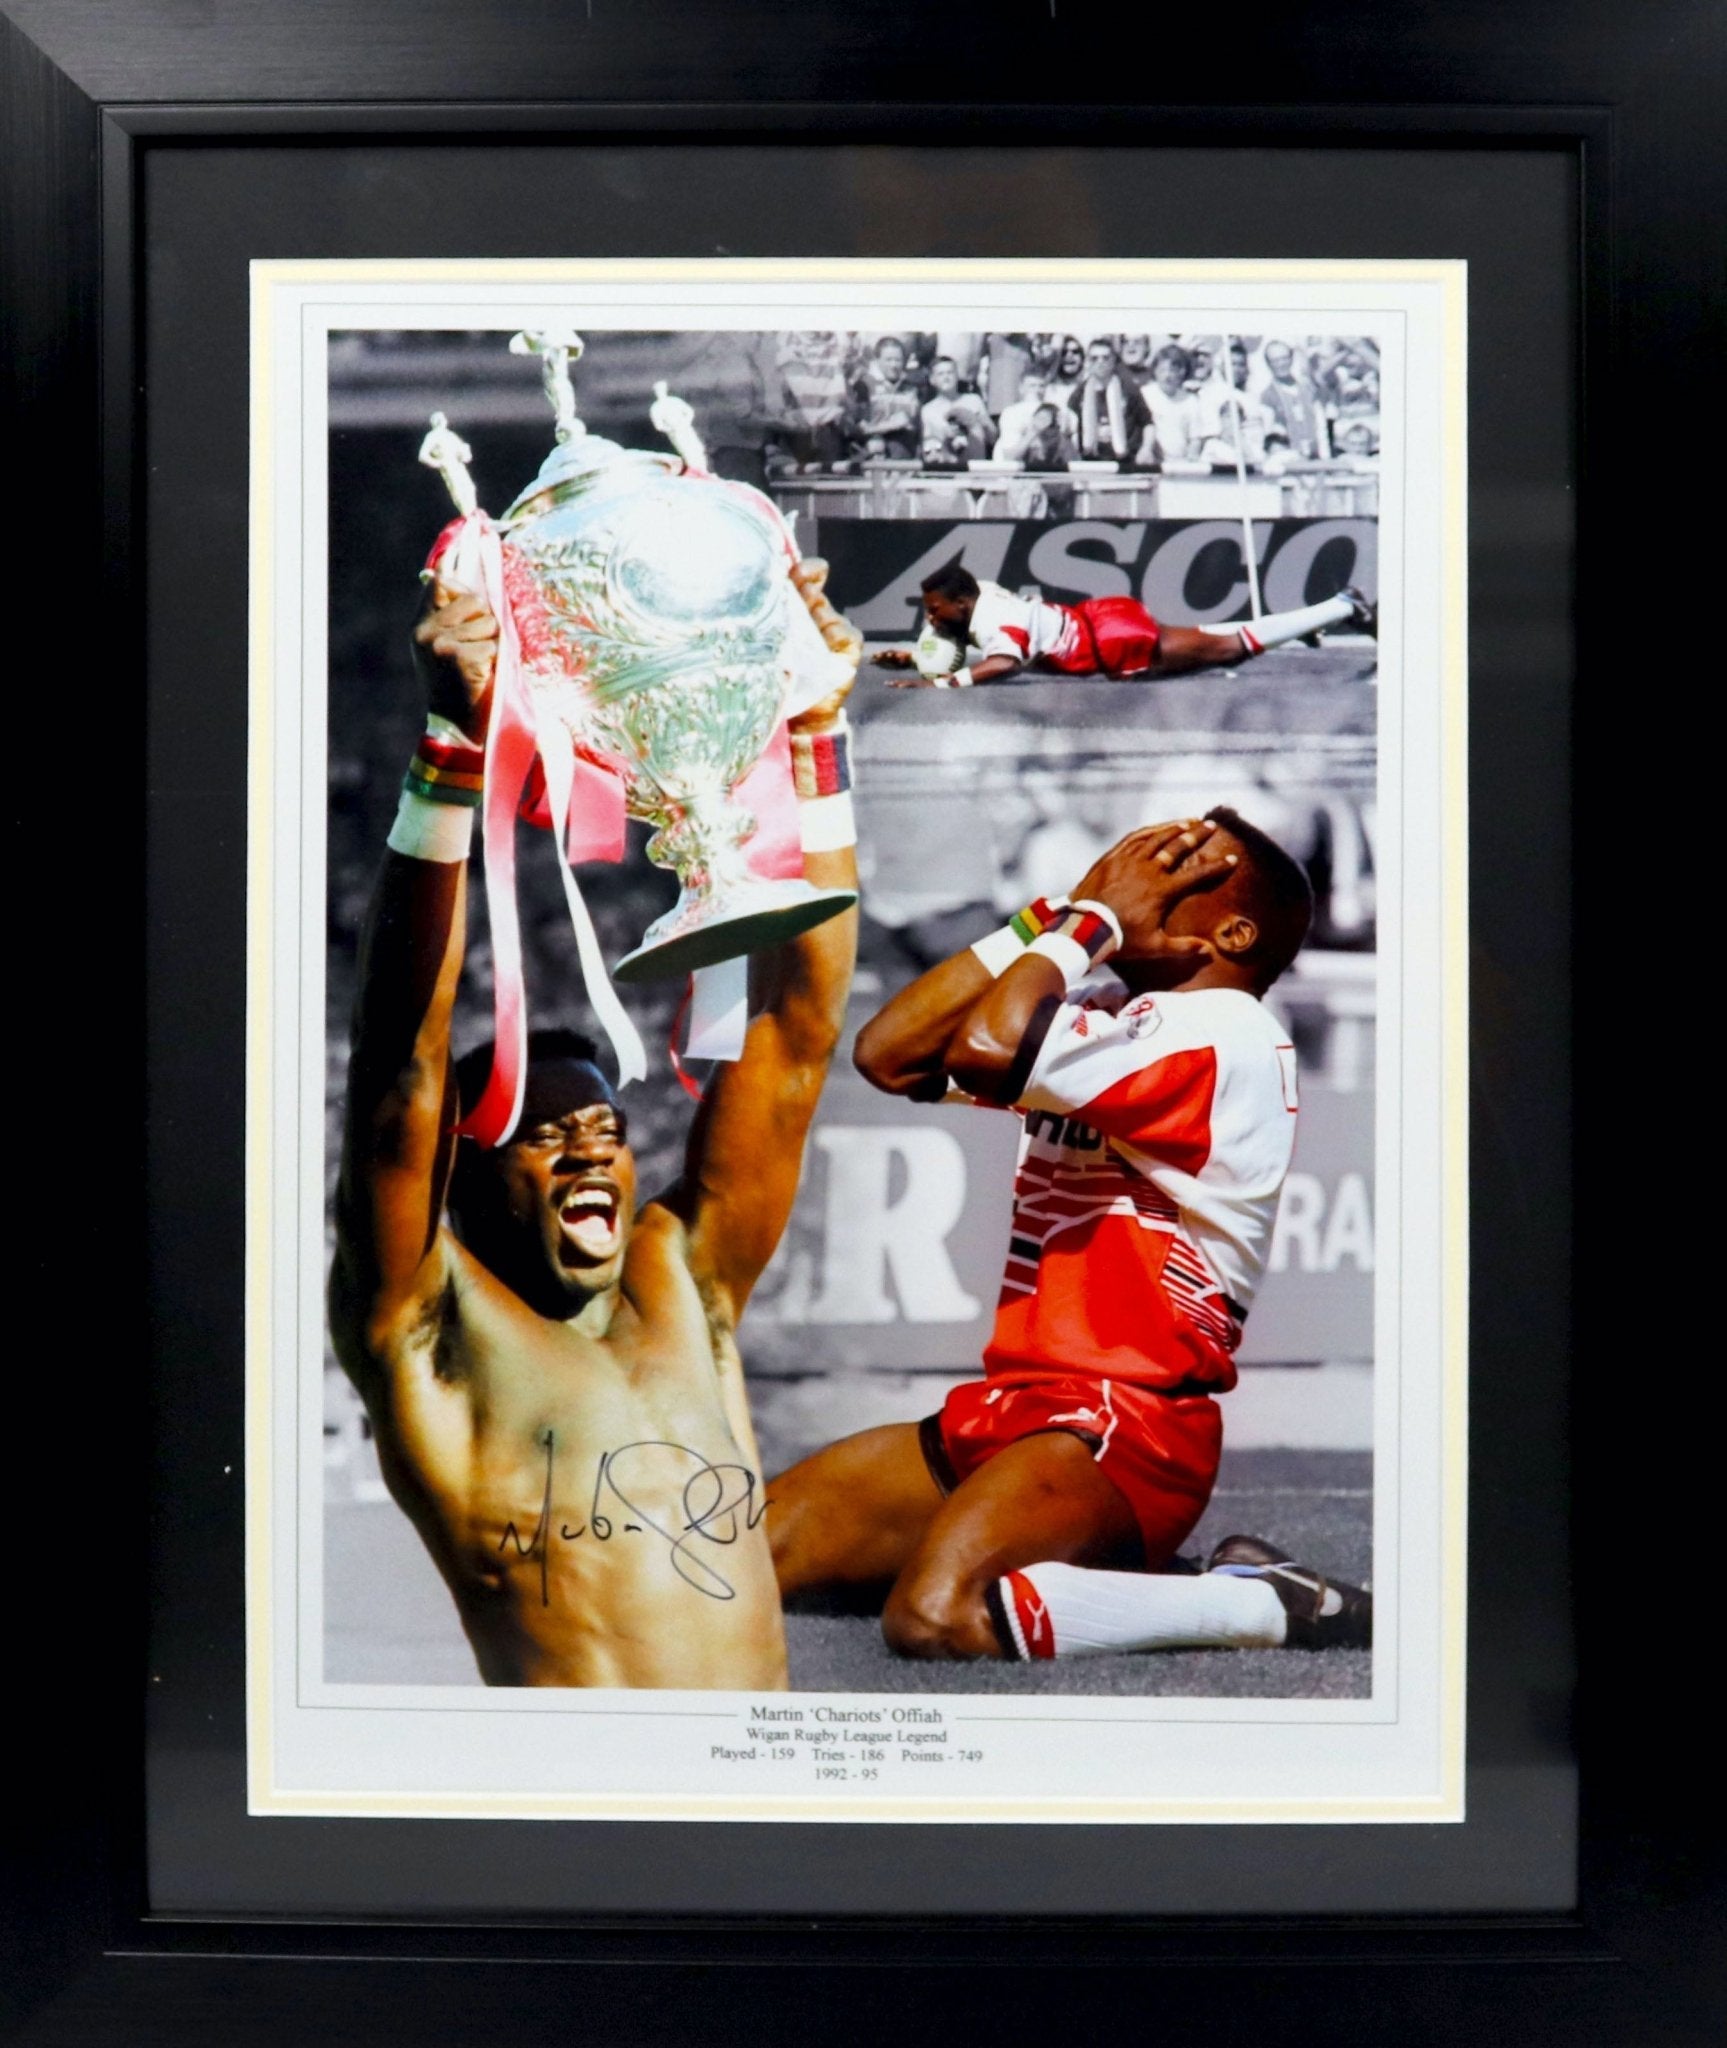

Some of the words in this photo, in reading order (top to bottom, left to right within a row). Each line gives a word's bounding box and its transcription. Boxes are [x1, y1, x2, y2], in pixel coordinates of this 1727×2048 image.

[750, 1705, 803, 1722] Martin
[891, 1707, 943, 1724] Offiah
[746, 1727, 790, 1744] Wigan
[794, 1728, 838, 1745] Rugby
[843, 1729, 892, 1745] League
[897, 1729, 947, 1746] Legend
[711, 1745, 756, 1762] Played
[771, 1747, 796, 1760] 159
[811, 1747, 846, 1761] Tries
[861, 1748, 885, 1761] 186
[901, 1748, 944, 1763] Points
[958, 1749, 983, 1763] 749
[815, 1767, 847, 1780] 1992
[861, 1768, 878, 1781] 95
